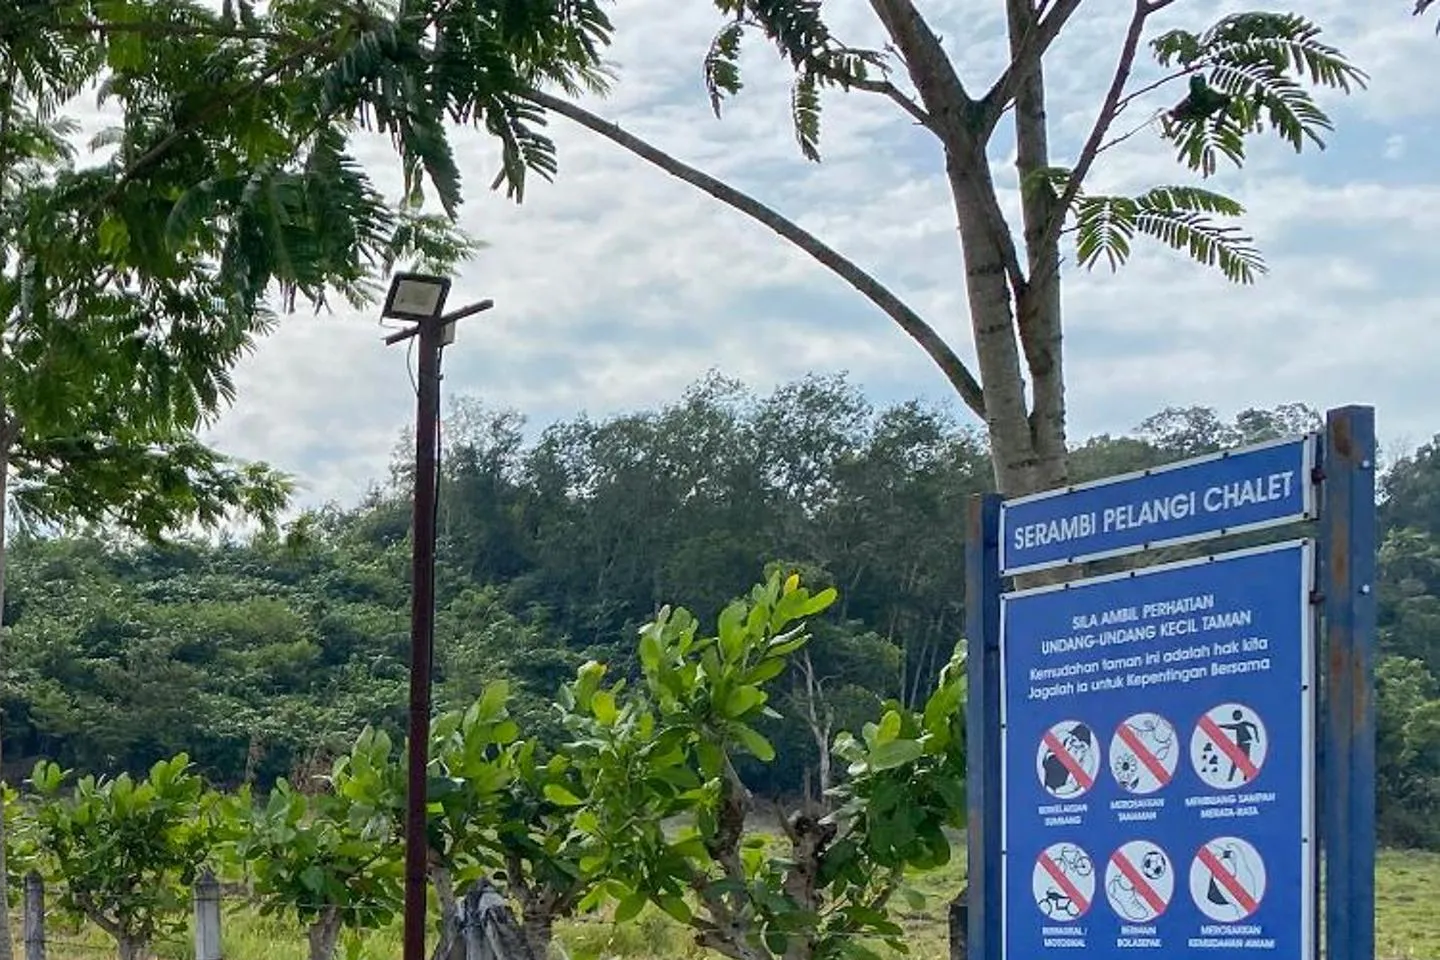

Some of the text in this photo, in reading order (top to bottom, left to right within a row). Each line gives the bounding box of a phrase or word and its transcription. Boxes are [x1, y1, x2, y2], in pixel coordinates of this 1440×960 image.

[1014, 471, 1293, 550] SERAMBI PELANGI CHALET
[1041, 610, 1252, 654] UNDANG-UNDANG KECIL TAMAN
[1072, 594, 1214, 630] SILA AMBIL PERHATIAN
[1027, 658, 1270, 700] Jagalah ia untuk Kepentingan Bersama
[1030, 637, 1268, 681] Kemudahan taman ini adalah hak kita
